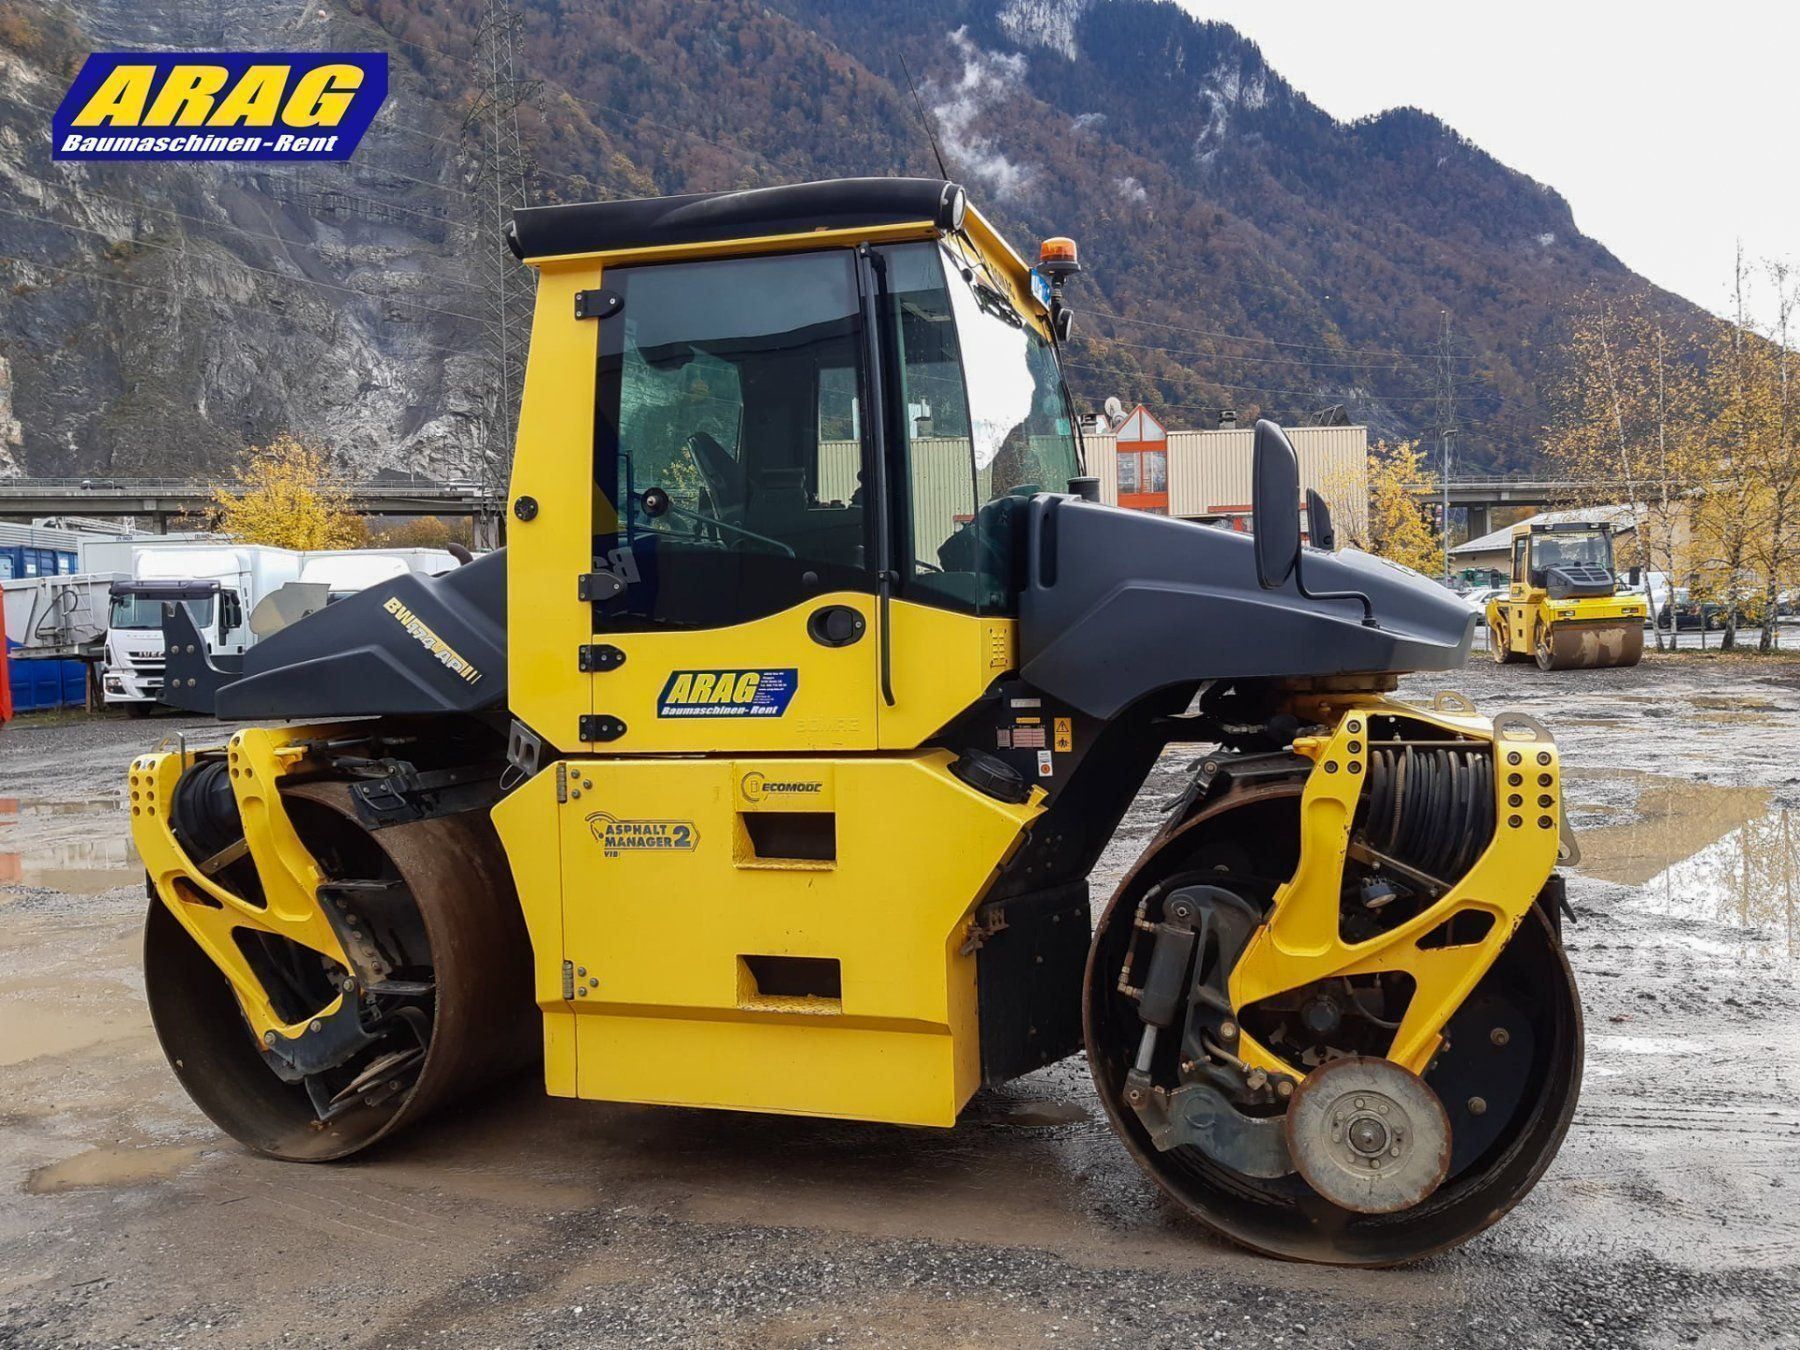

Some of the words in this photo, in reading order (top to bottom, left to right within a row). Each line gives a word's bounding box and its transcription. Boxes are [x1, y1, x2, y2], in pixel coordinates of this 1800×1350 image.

[665, 672, 760, 704] ARAG
[604, 836, 672, 847] MANAGER
[605, 824, 668, 835] ASPHALT
[672, 825, 691, 847] 2
